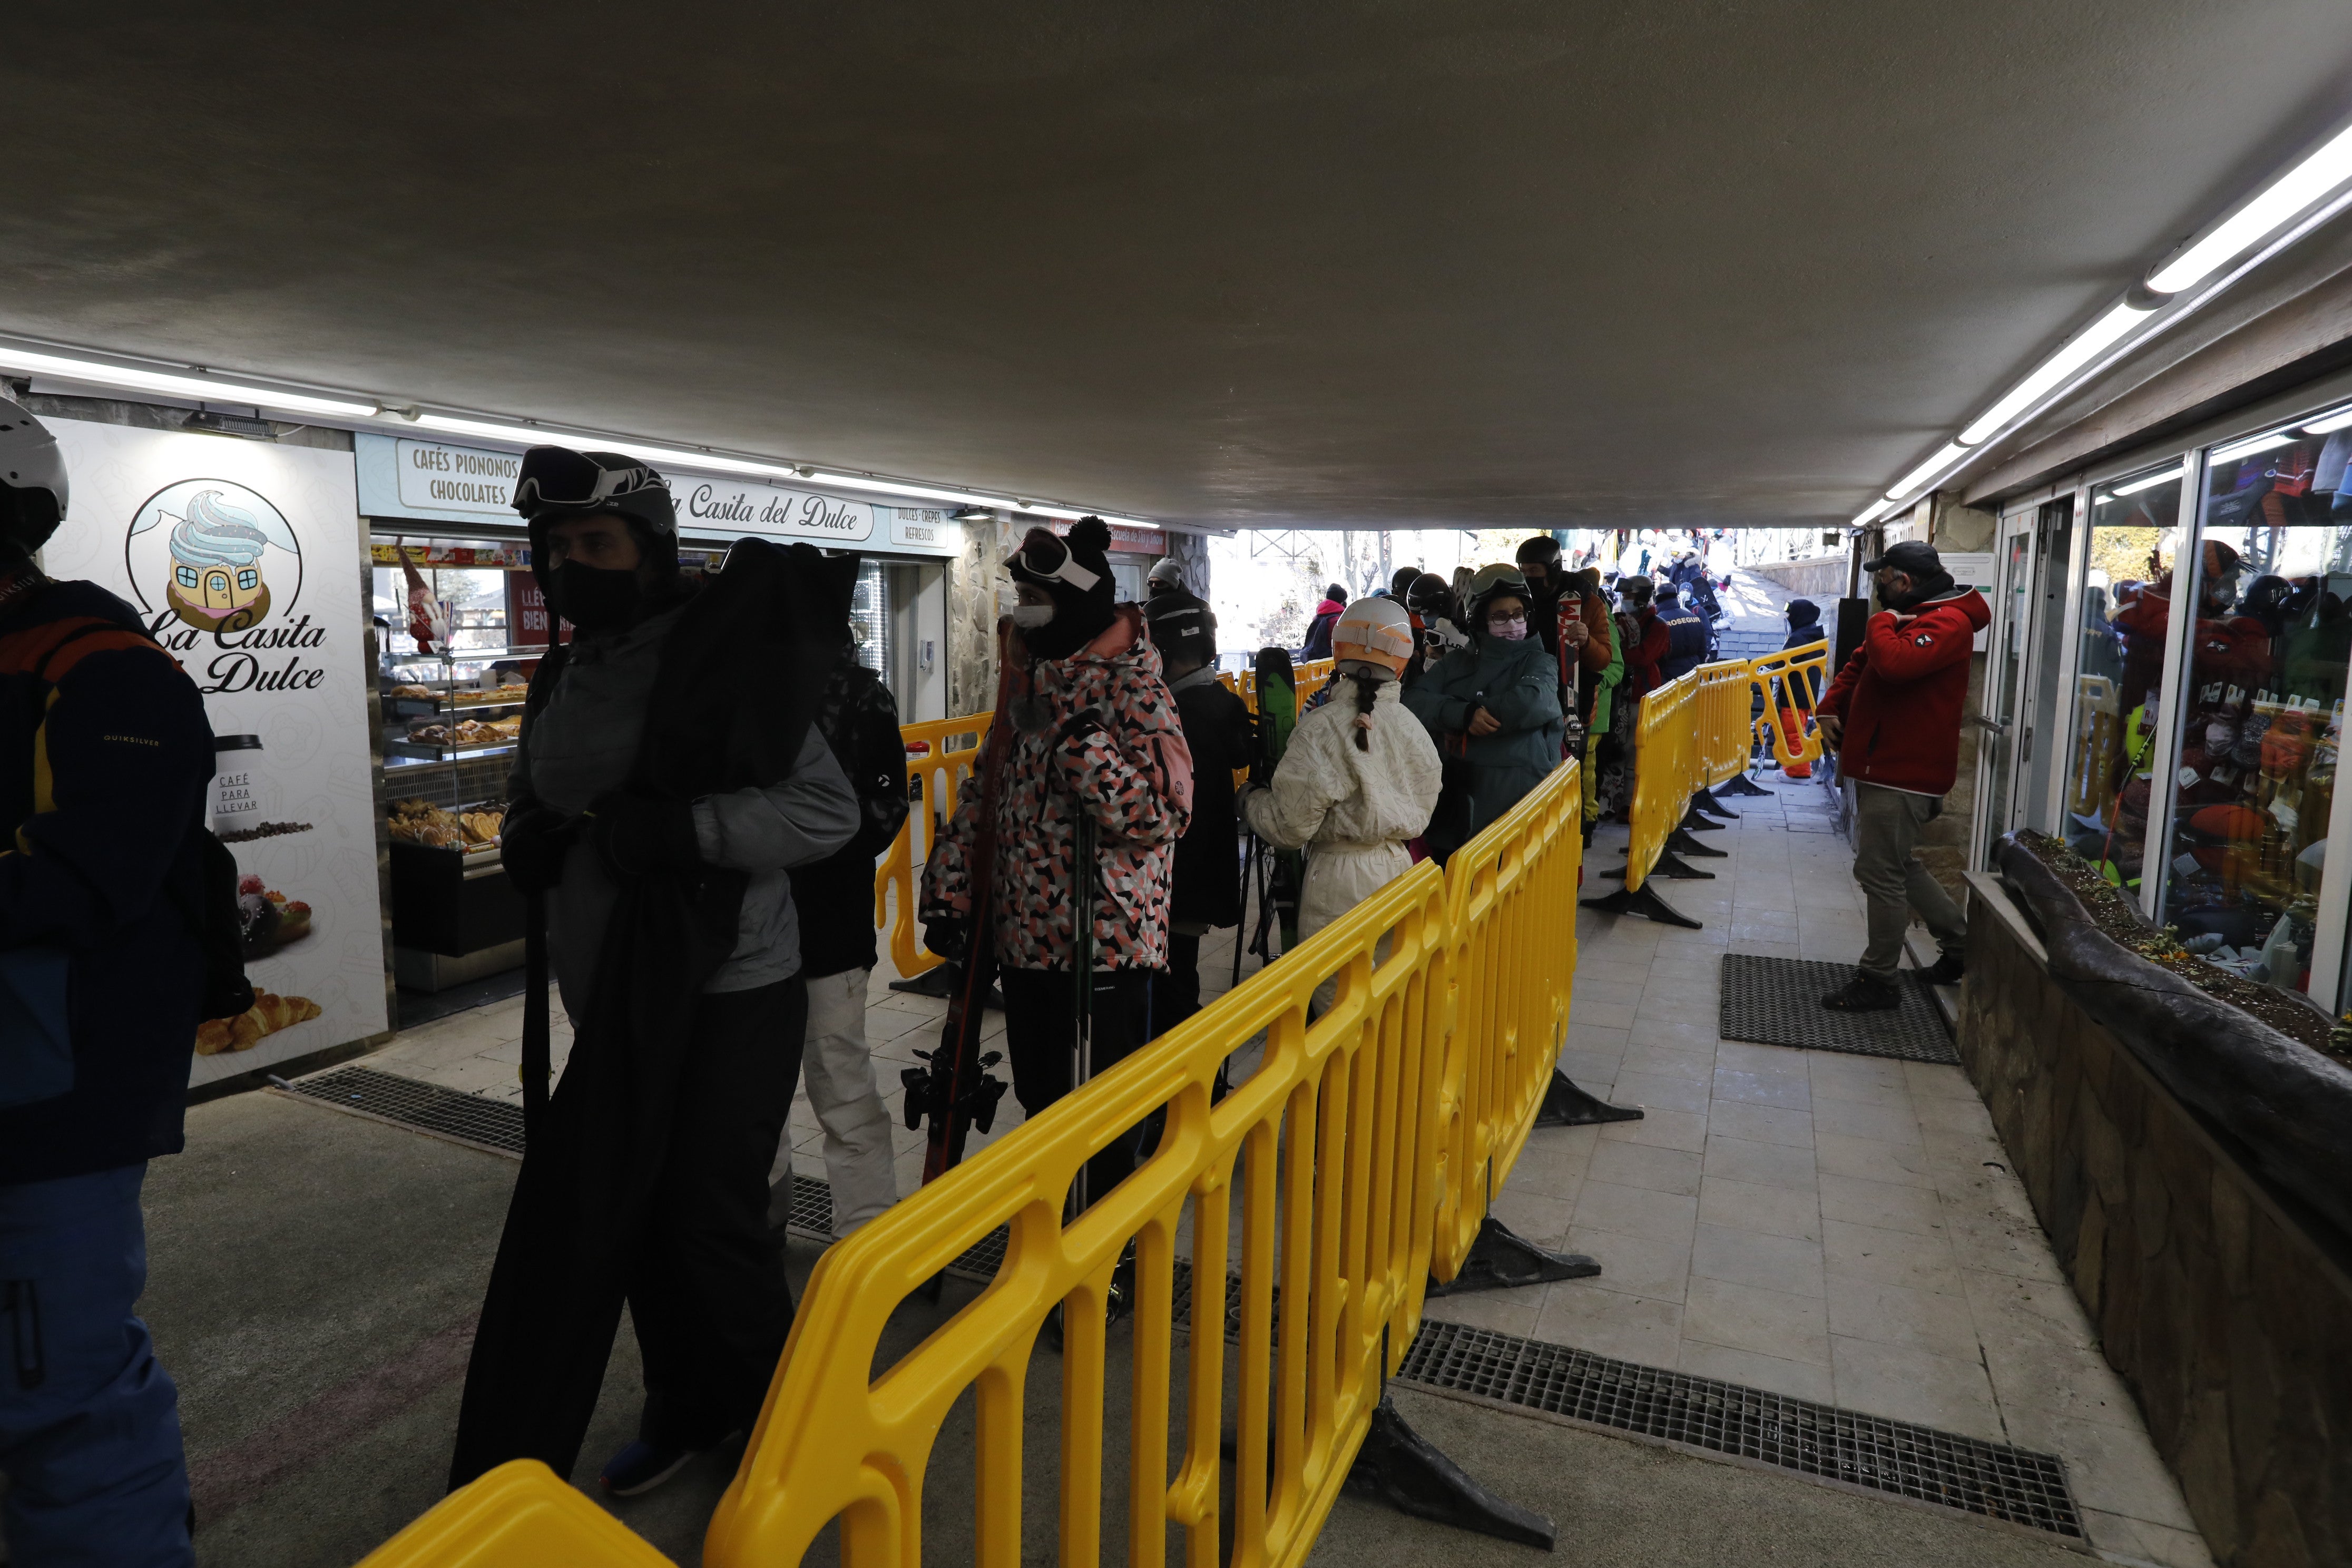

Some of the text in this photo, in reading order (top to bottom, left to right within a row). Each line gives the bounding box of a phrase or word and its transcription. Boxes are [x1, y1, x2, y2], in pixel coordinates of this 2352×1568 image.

[414, 446, 518, 479] CAFÉS PIONONOS
[430, 479, 506, 504] CHOCOLATES
[690, 484, 754, 523] Casita
[760, 496, 792, 524] del
[799, 496, 857, 530] Dulce
[898, 507, 940, 524] DULCES CREPES
[905, 526, 934, 541] REFRESCOS
[1055, 520, 1164, 547] Hap Escuela de Ski y Snow
[150, 608, 327, 651] La Casita
[523, 611, 548, 631] BIEN
[199, 652, 325, 694] Dulce
[104, 735, 159, 747] QUIKSILVER
[220, 773, 249, 787] CAFÉ
[221, 789, 250, 800] PARA
[216, 801, 257, 814] LLEVAR
